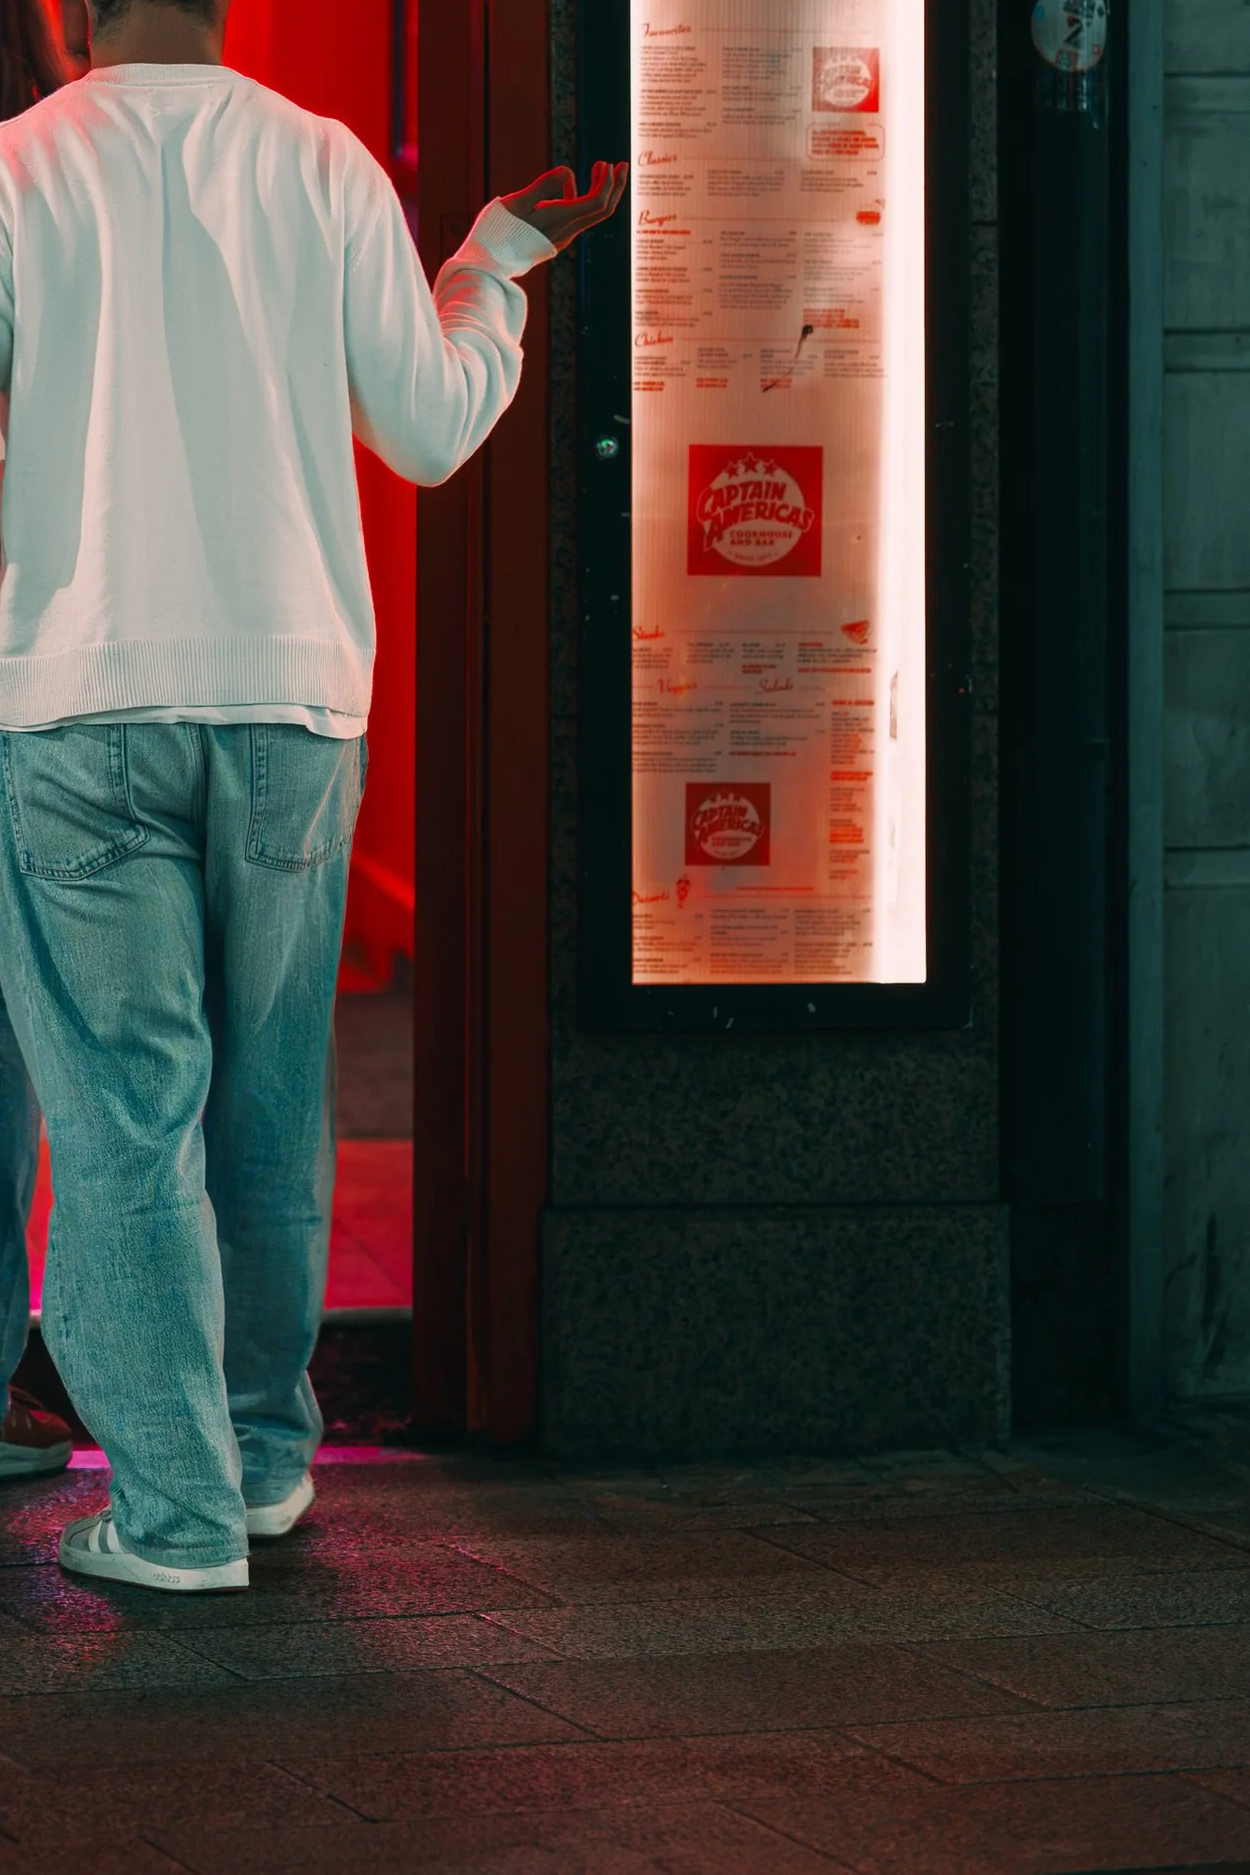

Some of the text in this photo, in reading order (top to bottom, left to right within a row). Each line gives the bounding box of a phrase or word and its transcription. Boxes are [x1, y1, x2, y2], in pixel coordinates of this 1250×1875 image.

[696, 480, 787, 525] CAPTAIN
[703, 501, 815, 553] AMERICAS
[730, 530, 793, 540] COOKHOUSE
